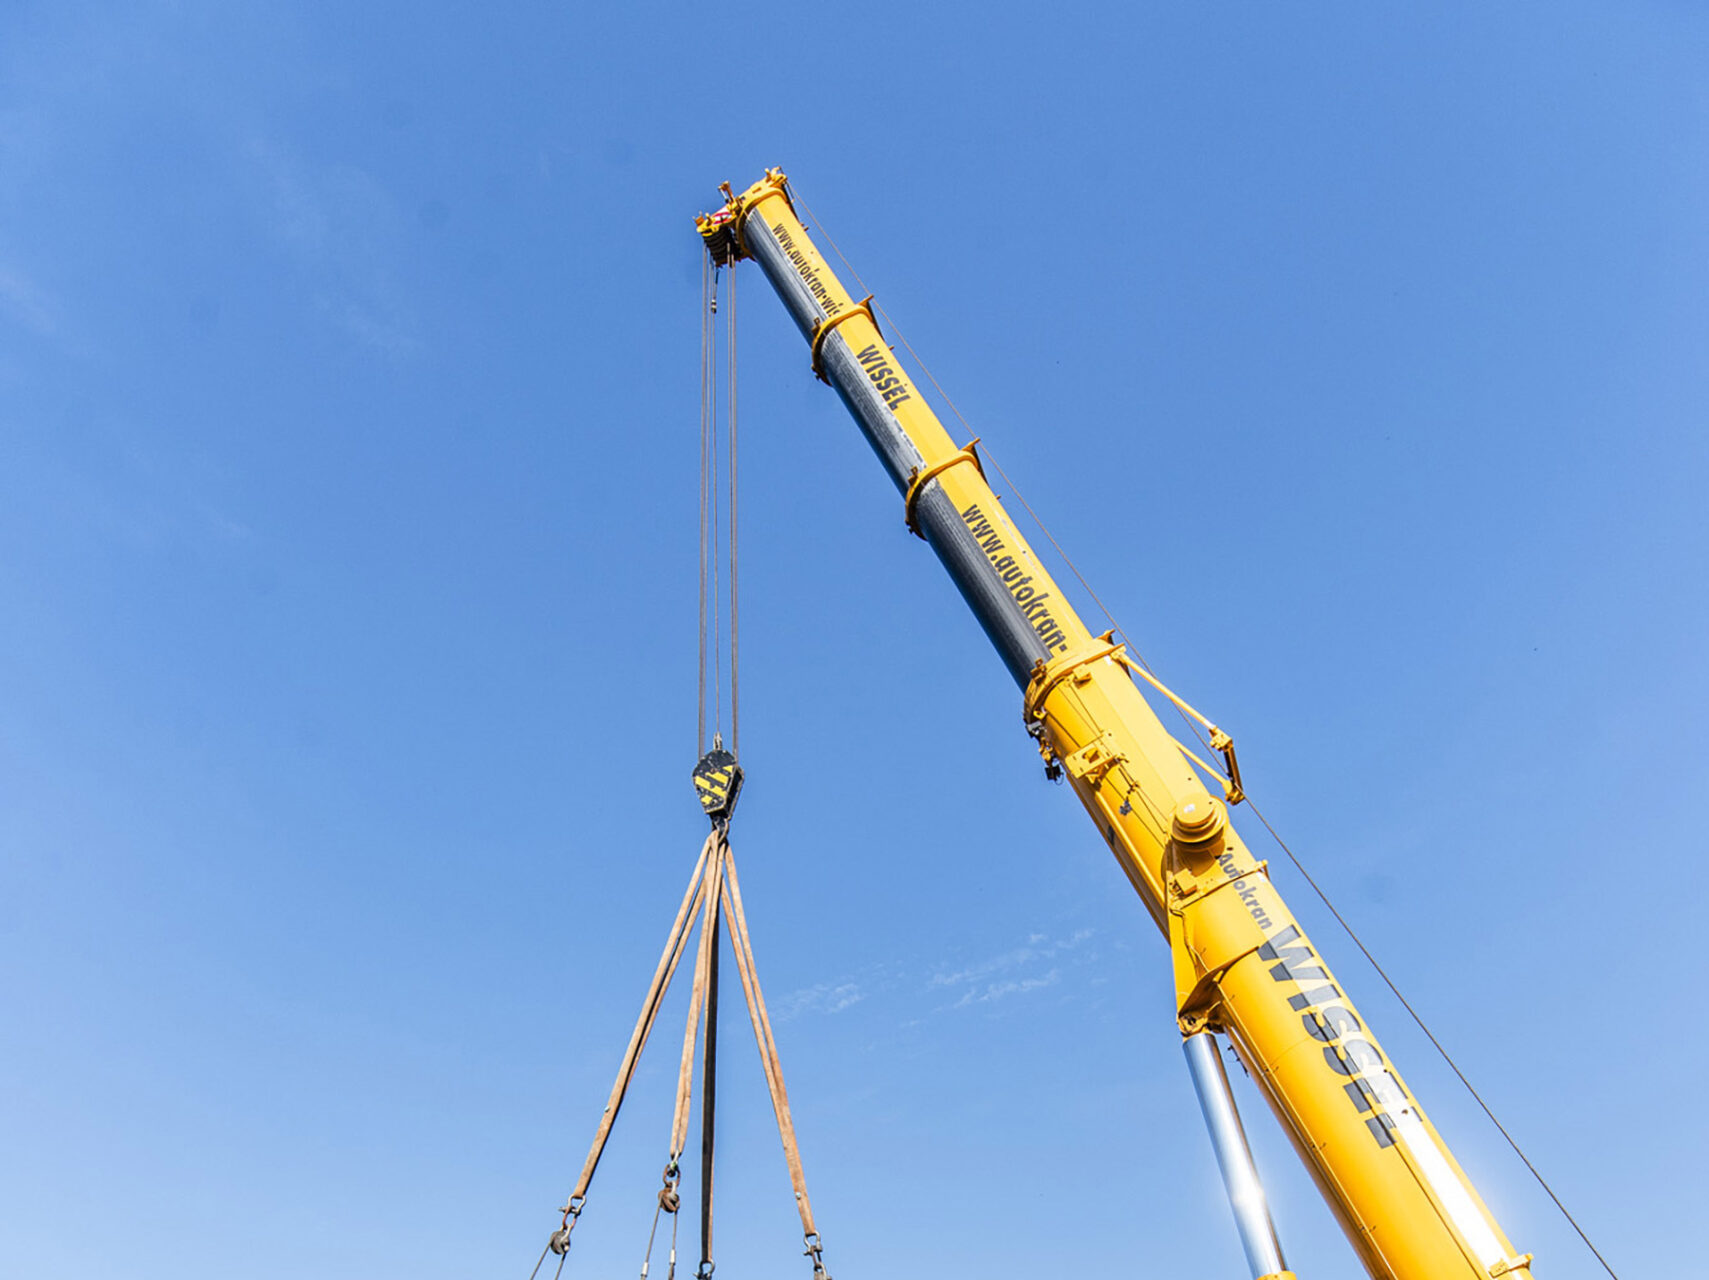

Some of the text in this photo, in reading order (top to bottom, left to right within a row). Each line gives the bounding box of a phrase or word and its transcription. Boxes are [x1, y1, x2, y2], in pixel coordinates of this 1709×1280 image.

[856, 344, 910, 410] WISSEL
[1218, 852, 1273, 930] Autokran
[1257, 924, 1423, 1149] WISSEL
